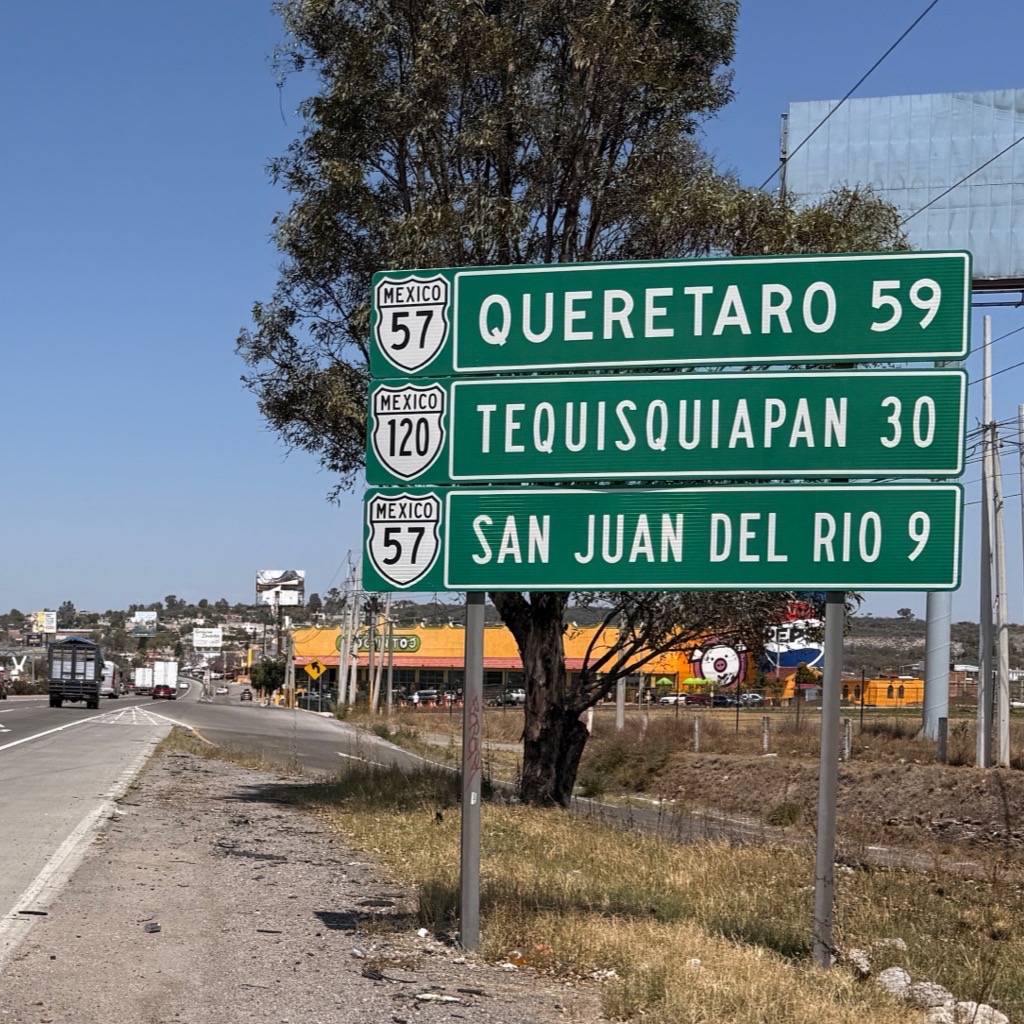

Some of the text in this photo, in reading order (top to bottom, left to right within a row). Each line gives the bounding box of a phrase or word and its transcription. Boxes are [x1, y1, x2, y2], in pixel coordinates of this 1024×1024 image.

[384, 285, 441, 304] MEXICO
[479, 278, 942, 346] QUERETARO 59
[391, 310, 434, 351] 57
[381, 393, 438, 411] MEXICO
[387, 417, 430, 457] 120
[476, 395, 936, 454] TEQUISQUIAPAN 30
[376, 502, 433, 519] MEXICO
[382, 527, 425, 566] 57
[472, 511, 931, 565] SAN JUAN DEL RIO 9
